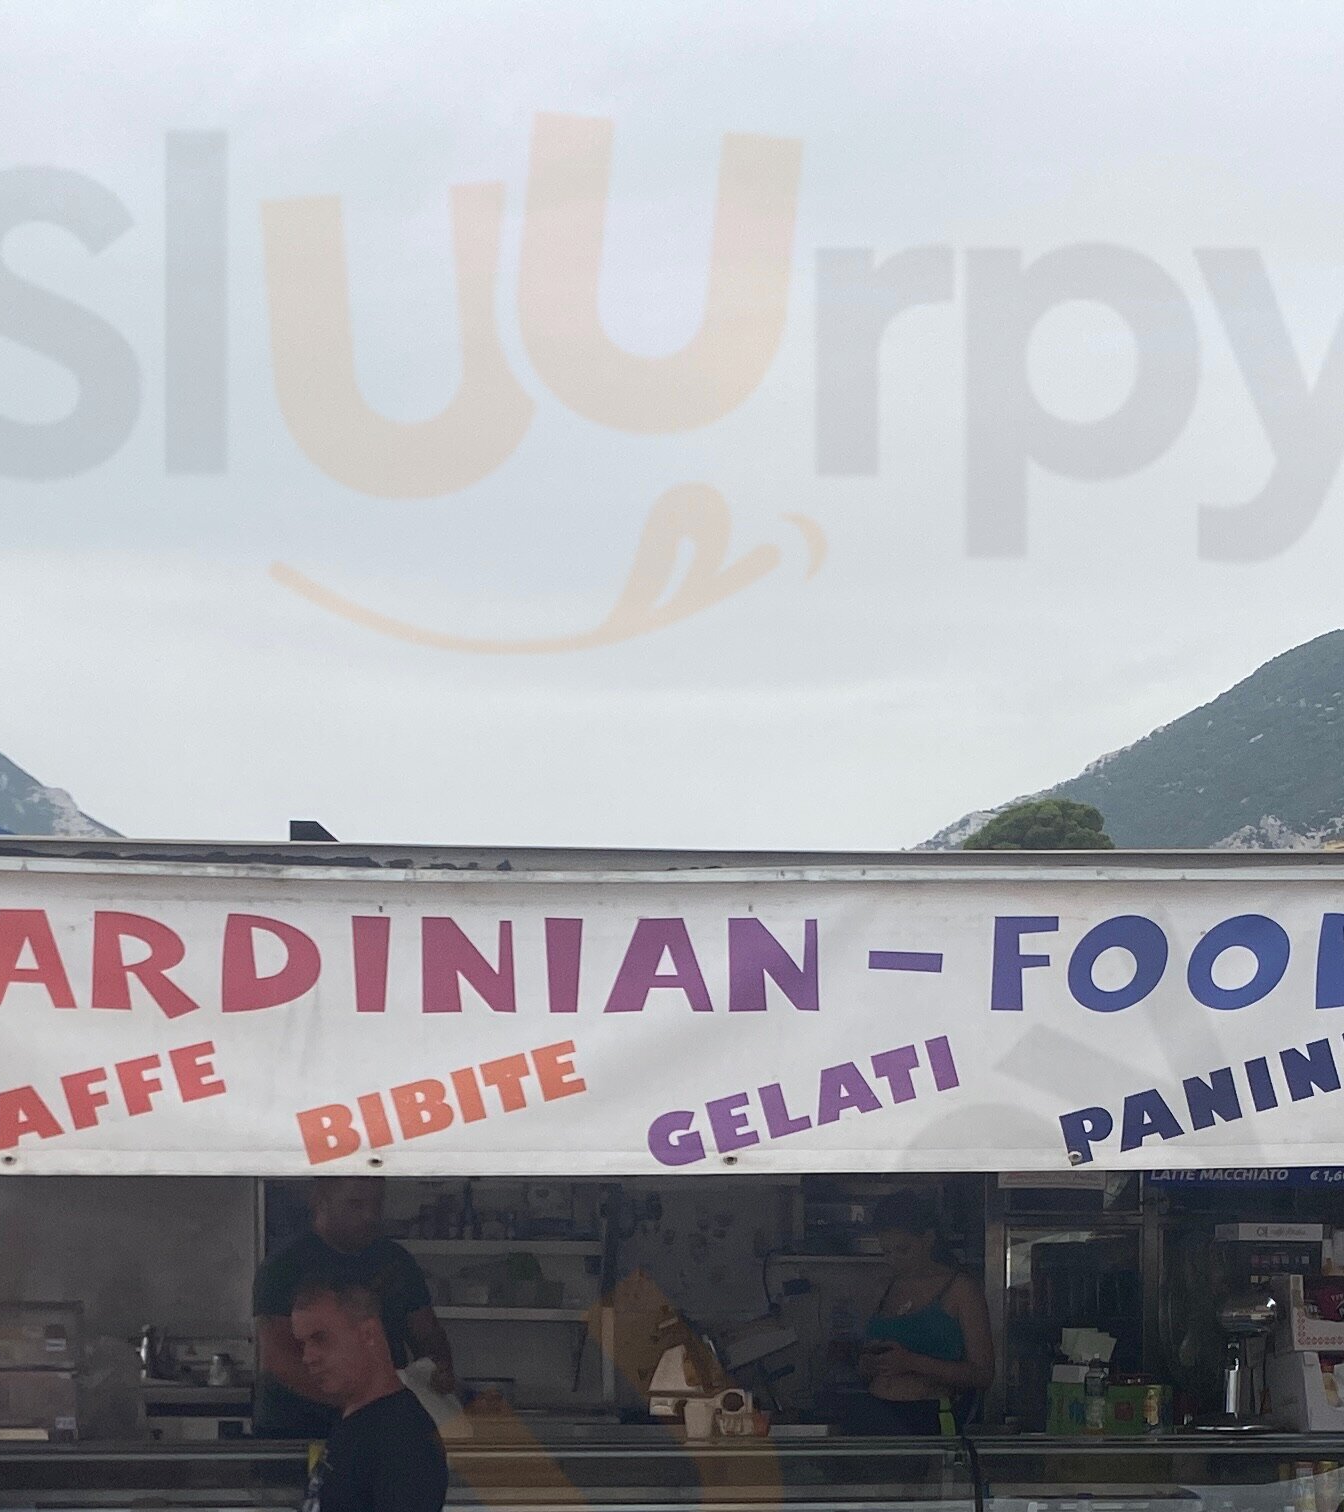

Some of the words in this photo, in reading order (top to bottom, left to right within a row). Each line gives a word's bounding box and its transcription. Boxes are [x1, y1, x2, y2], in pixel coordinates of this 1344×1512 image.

[296, 1039, 588, 1167] BIBITE
[646, 1035, 961, 1167] GELATI
[1150, 1168, 1195, 1181] LATTE
[1200, 1168, 1289, 1181] MACCHIATO
